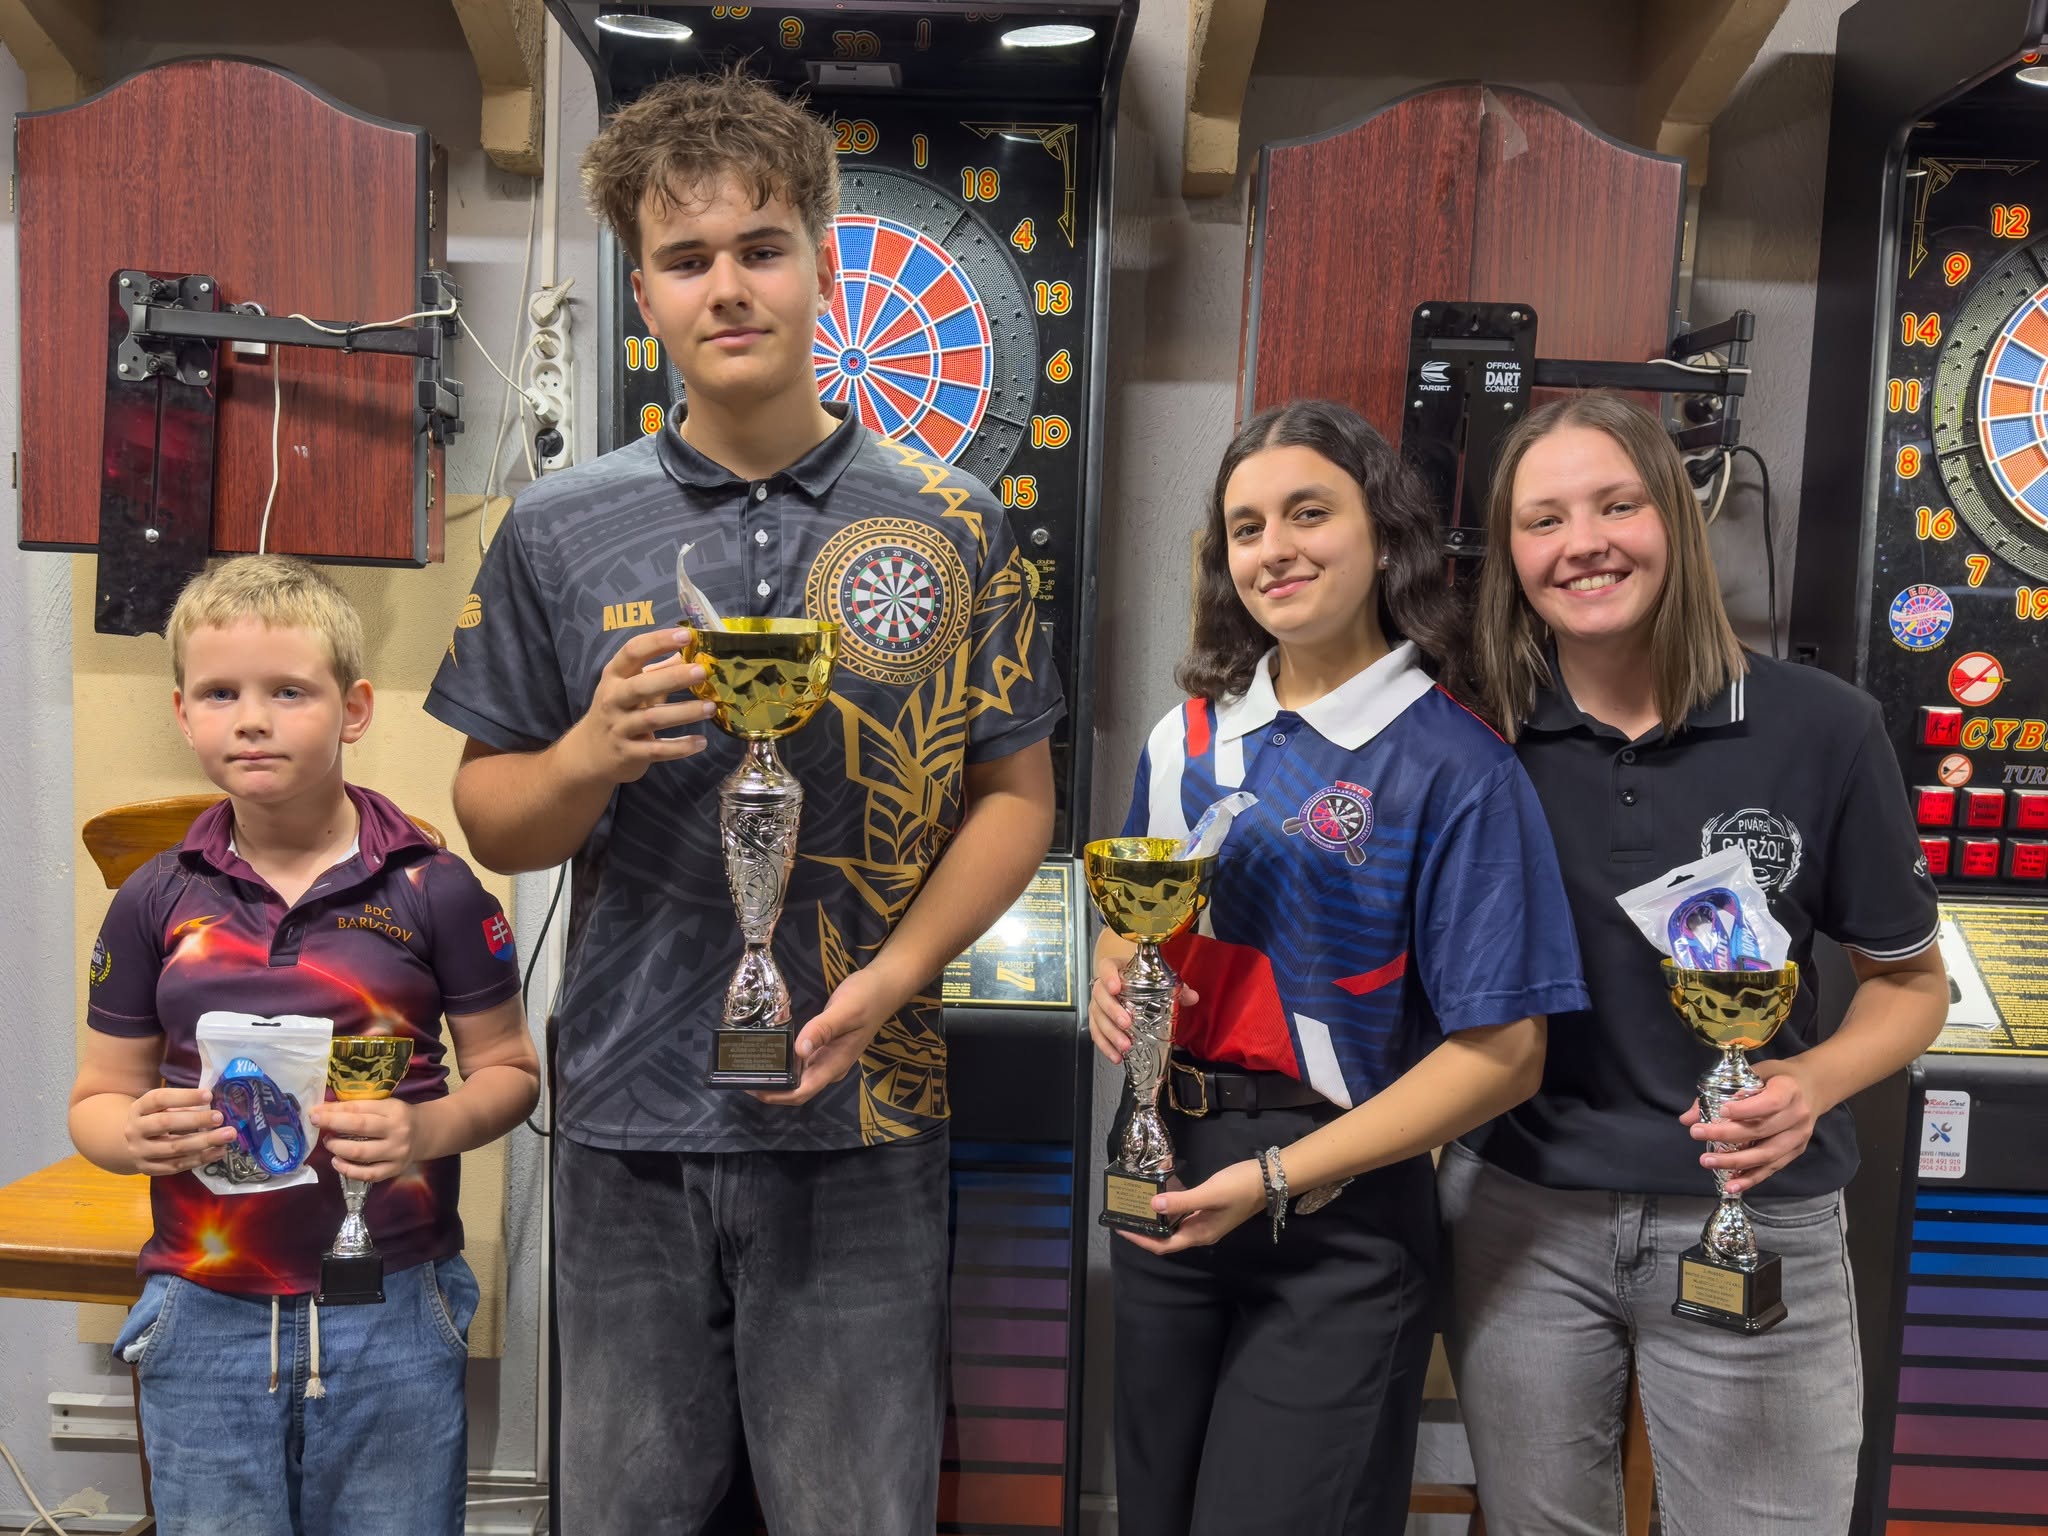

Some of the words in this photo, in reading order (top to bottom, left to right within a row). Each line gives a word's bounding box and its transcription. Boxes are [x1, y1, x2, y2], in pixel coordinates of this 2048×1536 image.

[835, 119, 879, 154] 20
[913, 134, 928, 168] 1
[961, 167, 1000, 202] 18
[1011, 218, 1036, 252] 4
[1991, 203, 2030, 239] 12
[1943, 252, 1971, 287] 9
[1034, 280, 1072, 315] 13
[1901, 312, 1942, 347] 14
[625, 336, 659, 371] 11
[1046, 349, 1072, 383] 6
[1486, 361, 1521, 370] OFFICIAL
[1418, 384, 1451, 392] TARGET
[1484, 385, 1519, 393] CONNECT
[1485, 371, 1521, 386] DART
[1888, 379, 1921, 412] 11
[640, 403, 664, 436] 8
[1030, 415, 1071, 448] 10
[1896, 445, 1921, 479] 8
[1000, 475, 1037, 509] 15
[1916, 506, 1956, 541] 16
[1965, 554, 1990, 588] 7
[1908, 586, 1938, 597] EDU
[2016, 586, 2048, 620] 19
[603, 600, 656, 632] ALEX
[1960, 716, 2048, 752] CYB
[2002, 765, 2048, 785] TUR
[364, 903, 393, 920] BDC
